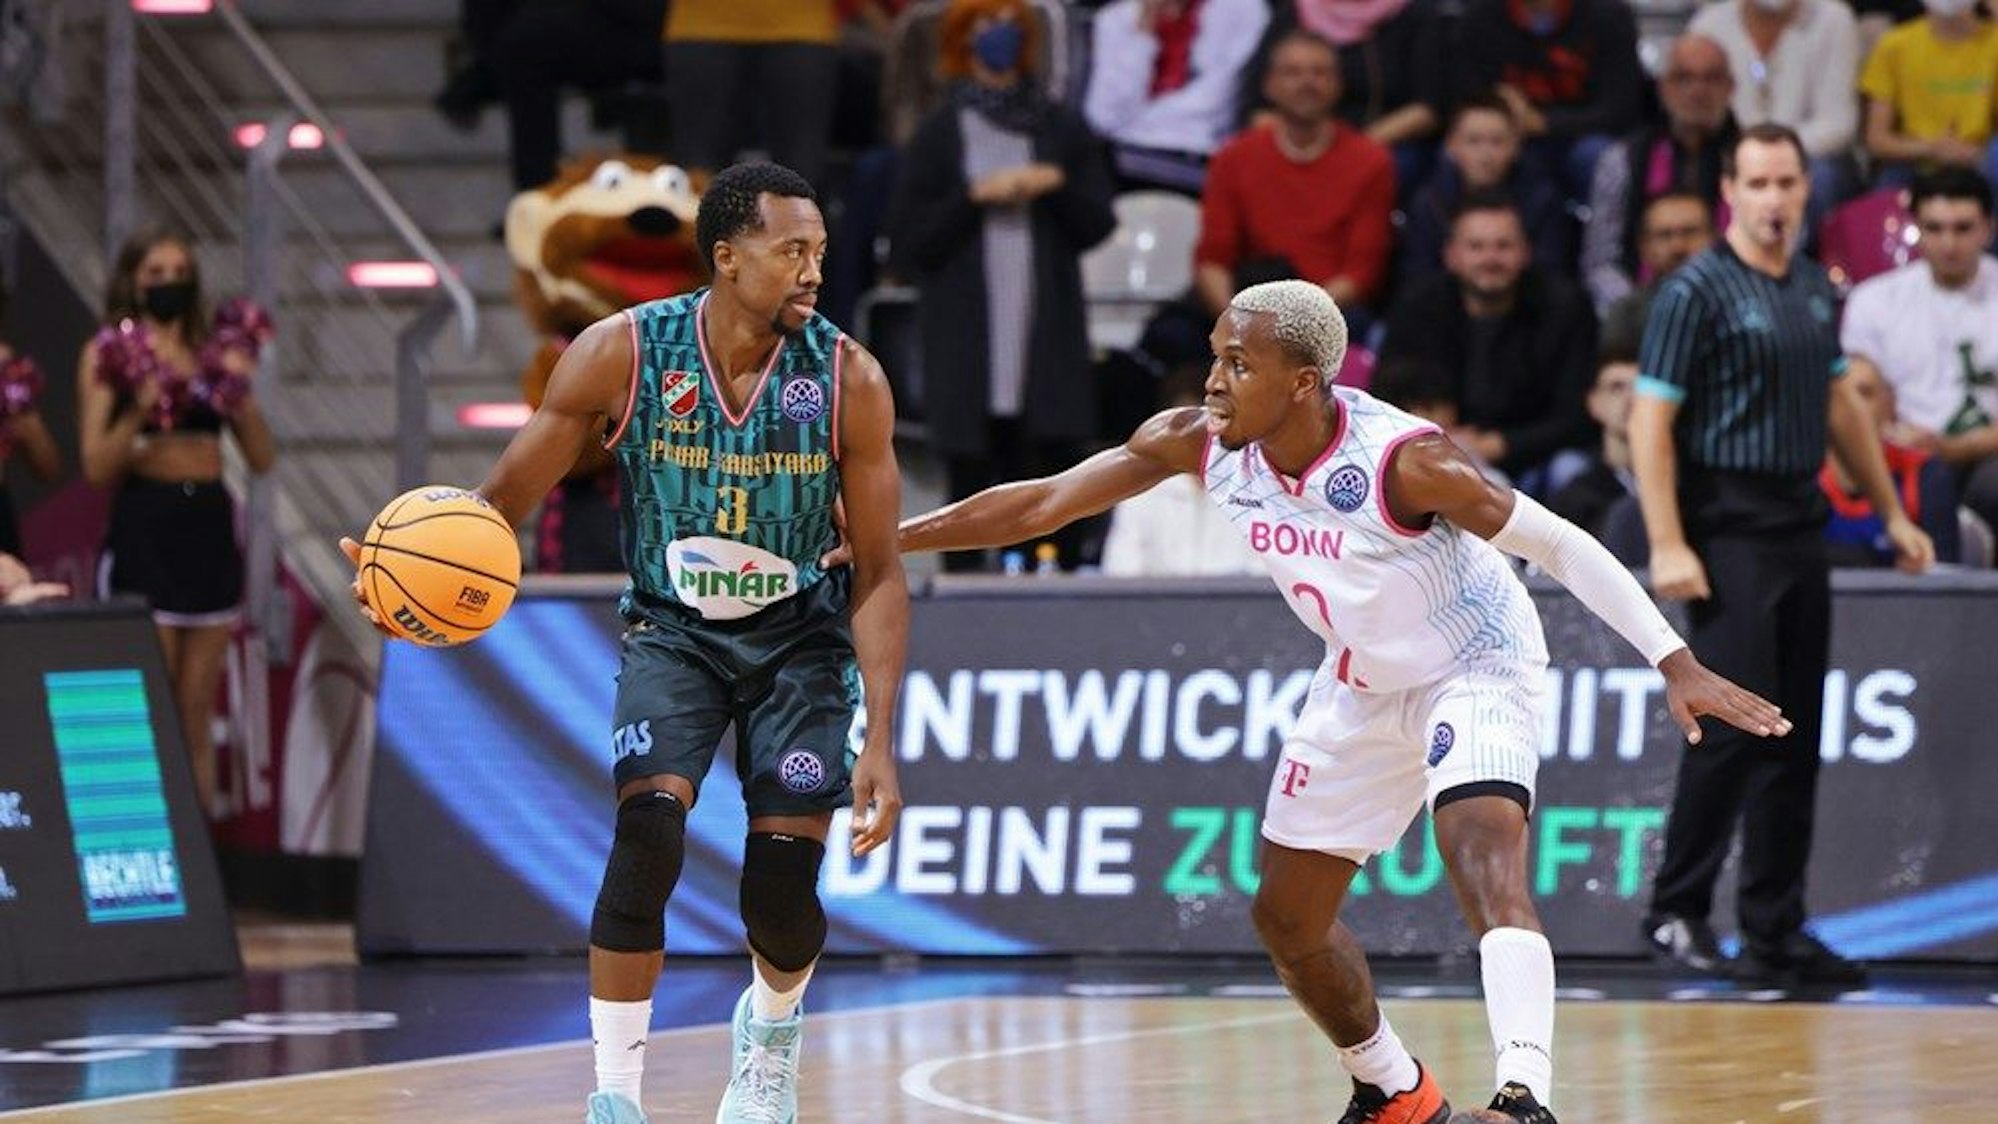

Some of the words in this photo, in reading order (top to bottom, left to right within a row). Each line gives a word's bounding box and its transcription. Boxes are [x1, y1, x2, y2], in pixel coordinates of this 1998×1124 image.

[715, 485, 749, 534] 3
[459, 586, 490, 606] FIBA
[847, 669, 1315, 761] NTWICK
[820, 805, 1140, 896] DEINE
